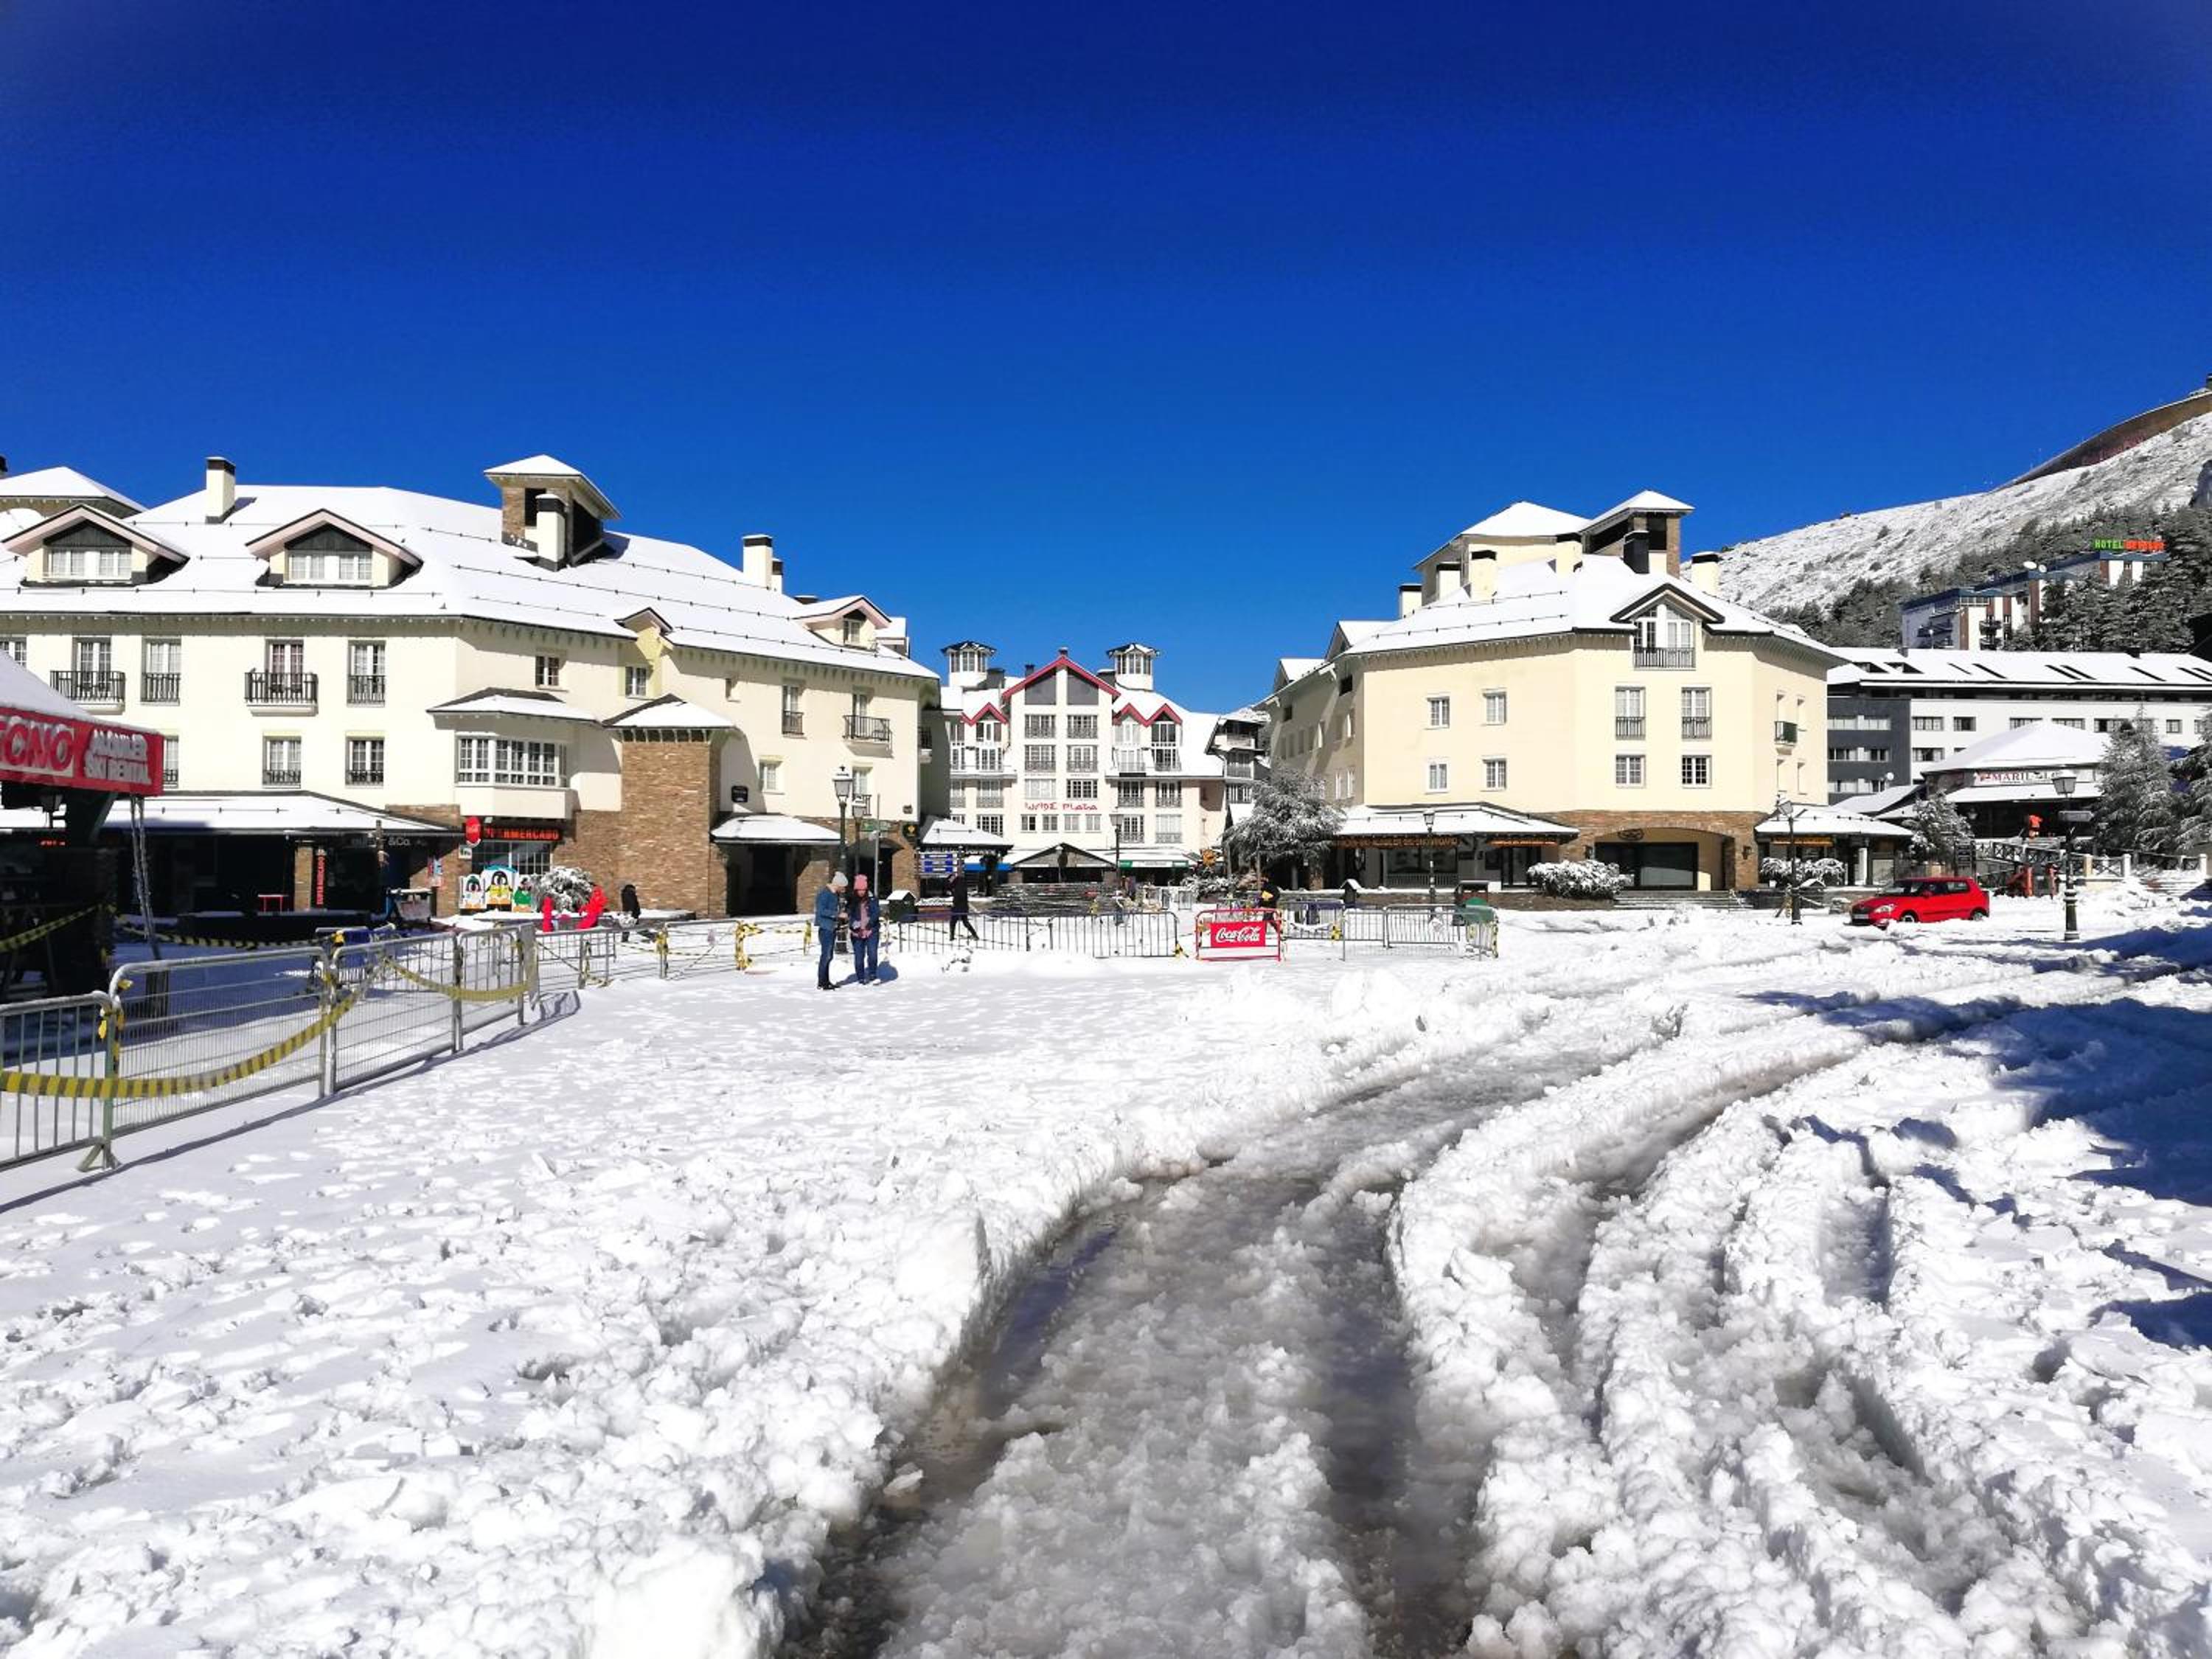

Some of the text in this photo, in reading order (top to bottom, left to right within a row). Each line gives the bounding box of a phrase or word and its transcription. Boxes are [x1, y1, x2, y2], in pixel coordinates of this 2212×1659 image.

[2095, 539, 2124, 549] HOTEL
[484, 827, 560, 839] RMERCADO
[1216, 925, 1262, 943] Coca-Cola
